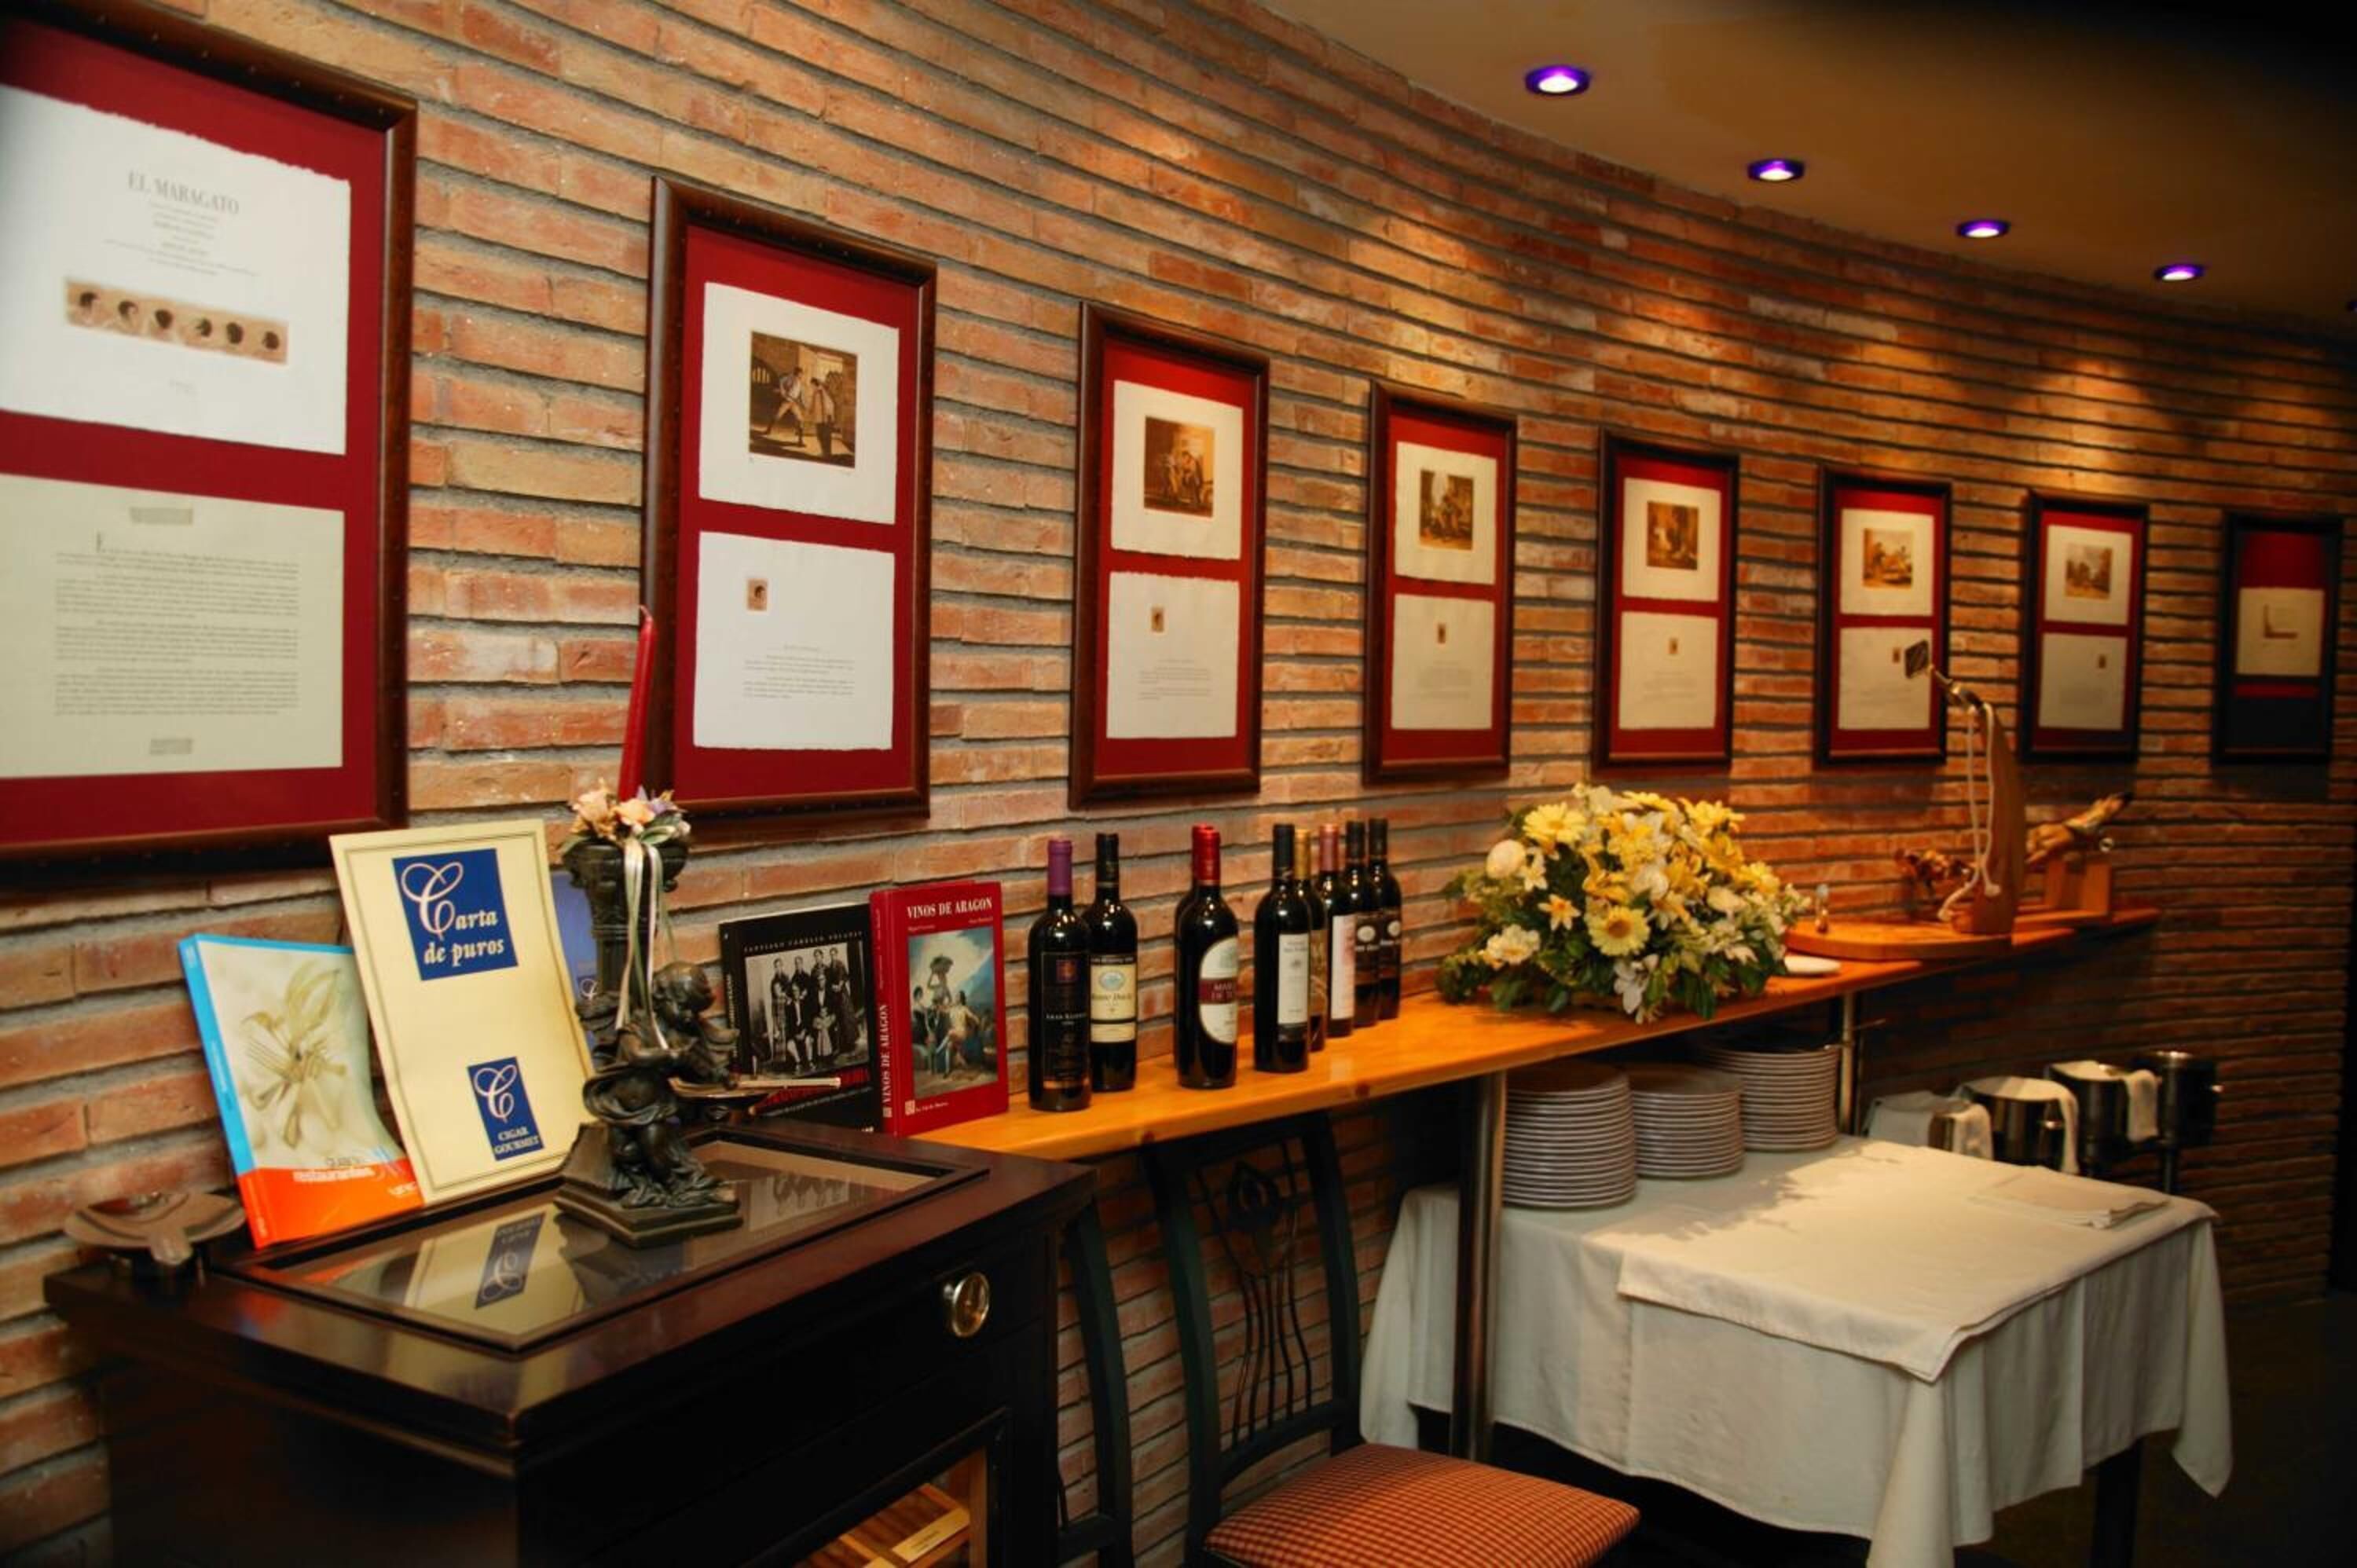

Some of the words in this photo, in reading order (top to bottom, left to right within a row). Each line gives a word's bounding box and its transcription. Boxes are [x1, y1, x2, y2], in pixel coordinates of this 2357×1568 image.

[127, 170, 151, 193] EL
[154, 178, 240, 215] MARAGATO
[401, 861, 499, 941] Carta
[906, 903, 937, 918] VINOS
[938, 901, 953, 916] DE
[423, 942, 446, 965] de
[450, 939, 505, 967] puros
[880, 1051, 890, 1068] DE
[882, 1071, 893, 1104] VINOS
[497, 1126, 530, 1141] CIGAR
